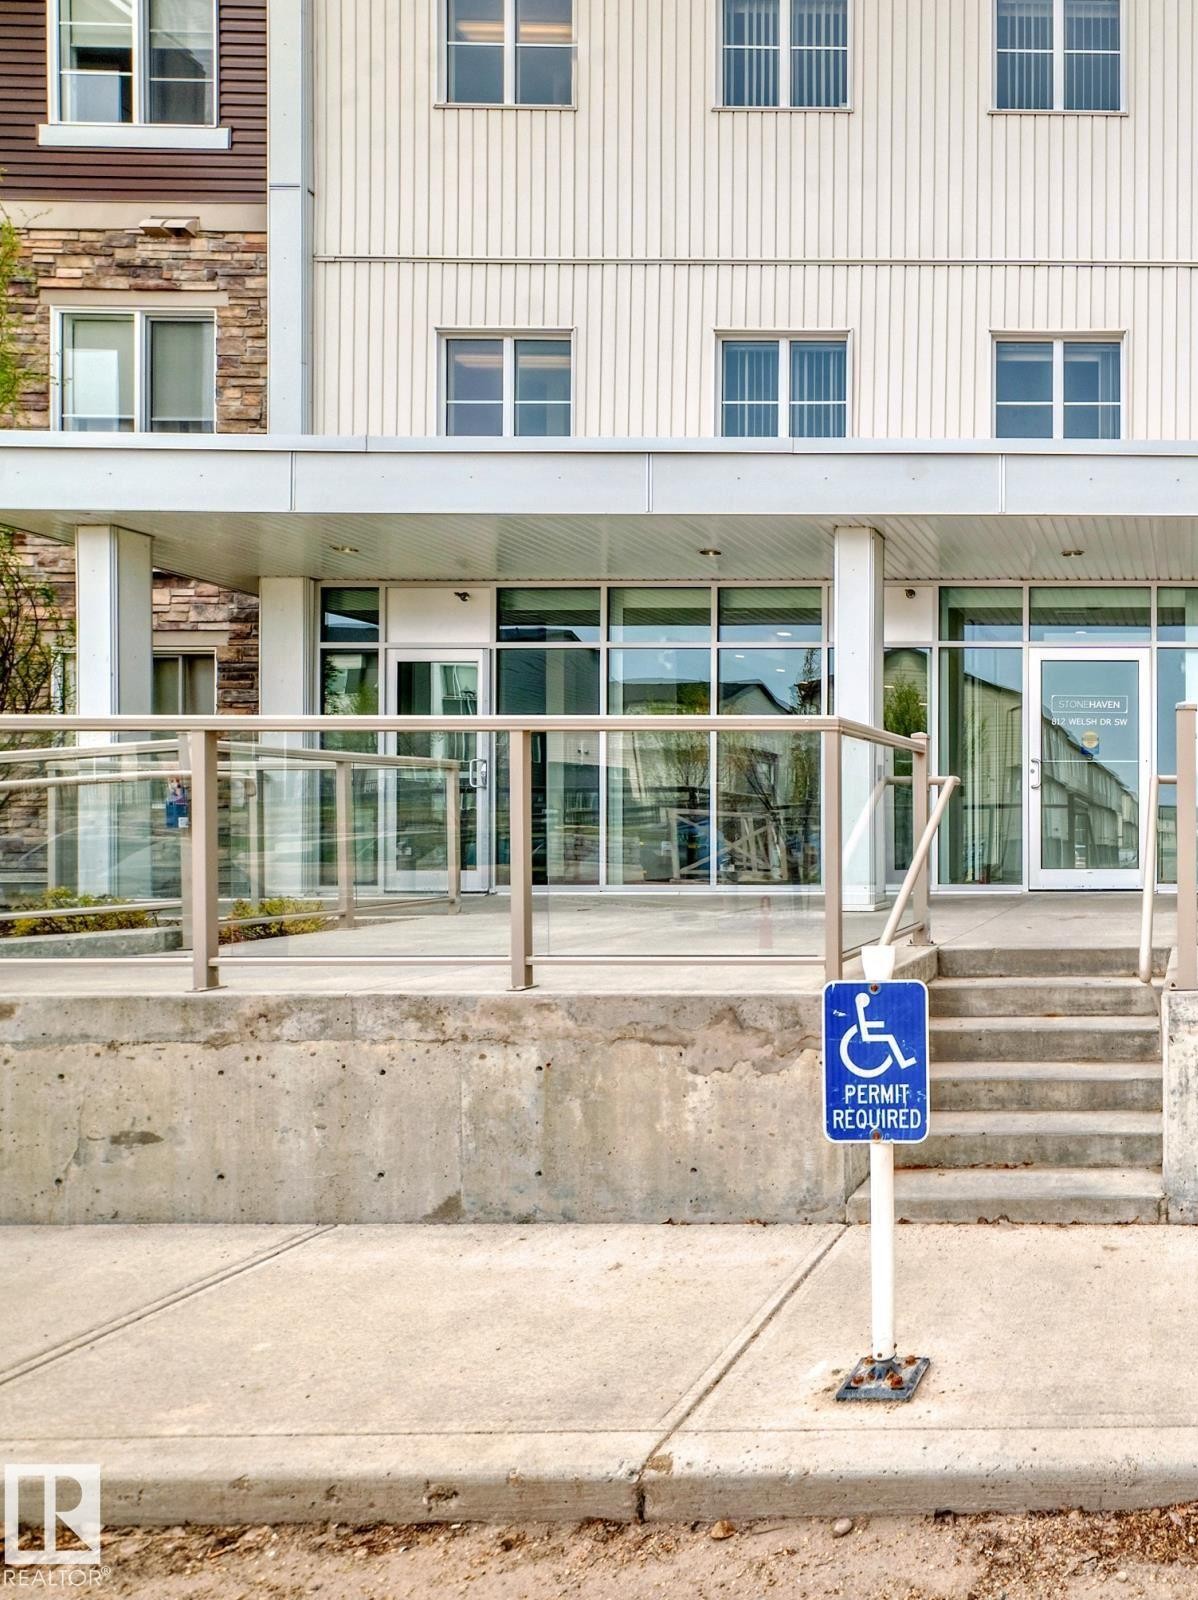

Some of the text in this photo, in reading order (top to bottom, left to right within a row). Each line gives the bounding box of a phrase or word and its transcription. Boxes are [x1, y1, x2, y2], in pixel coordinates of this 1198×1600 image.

[1059, 700, 1120, 709] STONEHAVEN
[1051, 718, 1128, 726] 812 WELSH DR SW
[844, 1084, 909, 1104] PERMIT
[833, 1109, 921, 1130] REQUIRED
